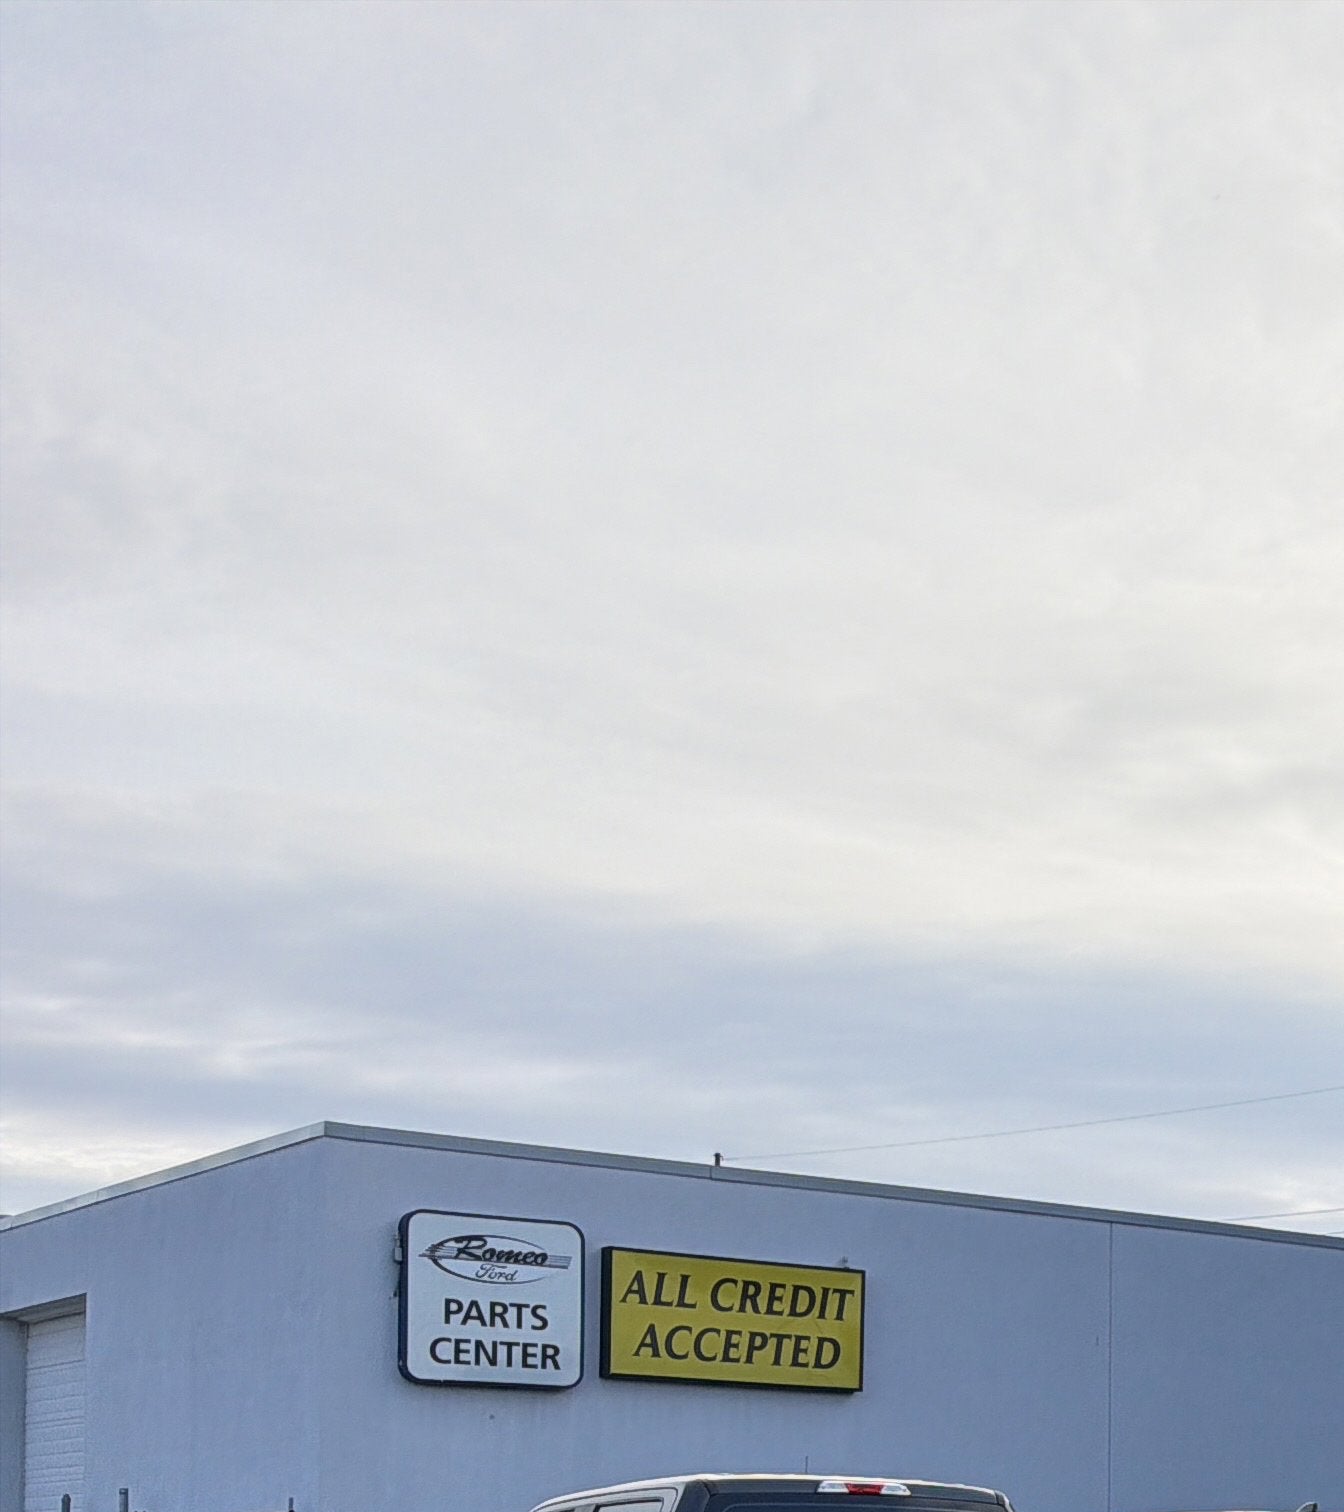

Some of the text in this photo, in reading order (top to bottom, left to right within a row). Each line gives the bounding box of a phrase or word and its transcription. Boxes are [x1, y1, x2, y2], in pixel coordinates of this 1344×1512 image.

[454, 1236, 549, 1266] Romeo
[475, 1262, 519, 1282] Ford
[620, 1270, 855, 1322] ALL CREDIT
[444, 1297, 549, 1332] PARTS
[429, 1336, 561, 1371] CENTER
[632, 1323, 842, 1370] ACCEPTED
